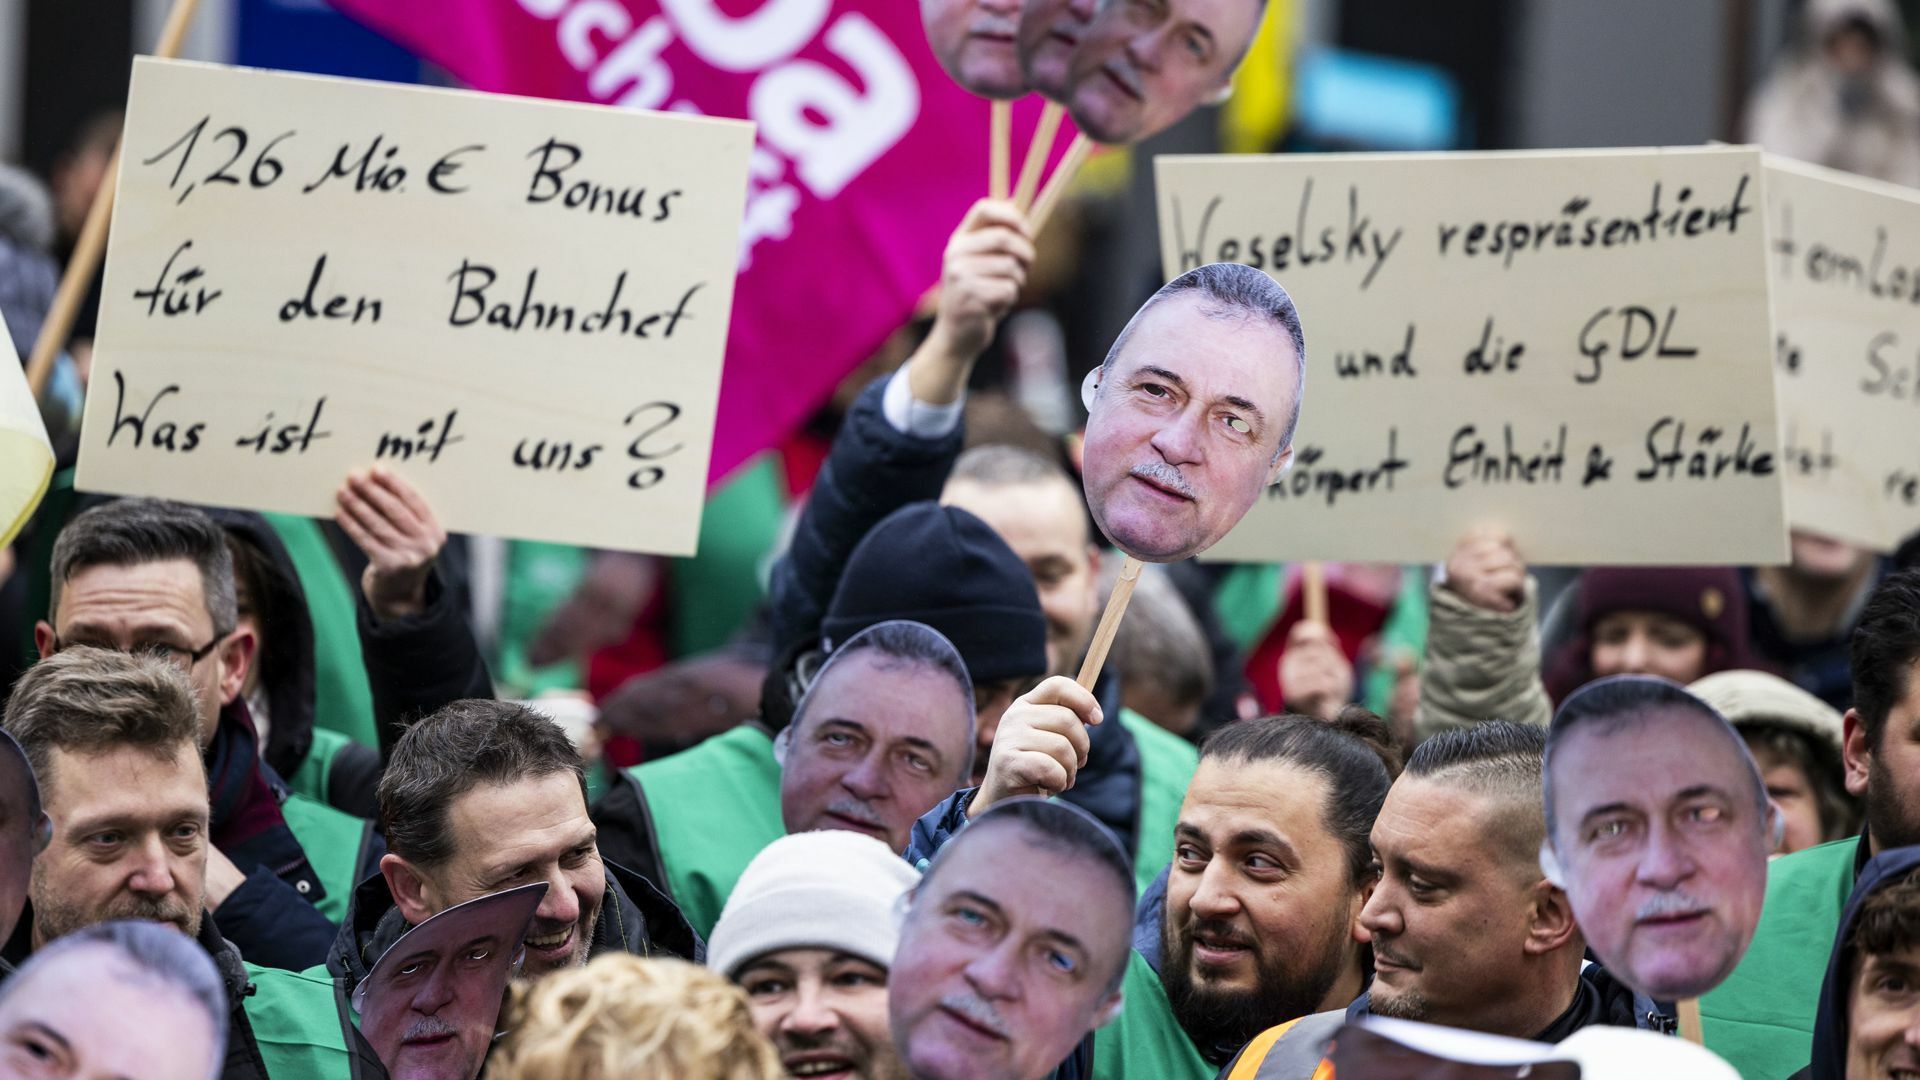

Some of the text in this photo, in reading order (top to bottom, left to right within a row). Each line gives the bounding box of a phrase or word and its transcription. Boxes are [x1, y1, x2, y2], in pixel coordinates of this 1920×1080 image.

[143, 114, 684, 223] 1,26 Mio. € Bonus
[1437, 172, 1752, 269] respräsentiert
[133, 239, 709, 340] für den Bahnchef
[1335, 303, 1702, 386] und die GDL
[106, 369, 688, 491] Was ist mit uns ?
[1442, 422, 1570, 492] Einheit
[1633, 414, 1780, 484] Stärke
